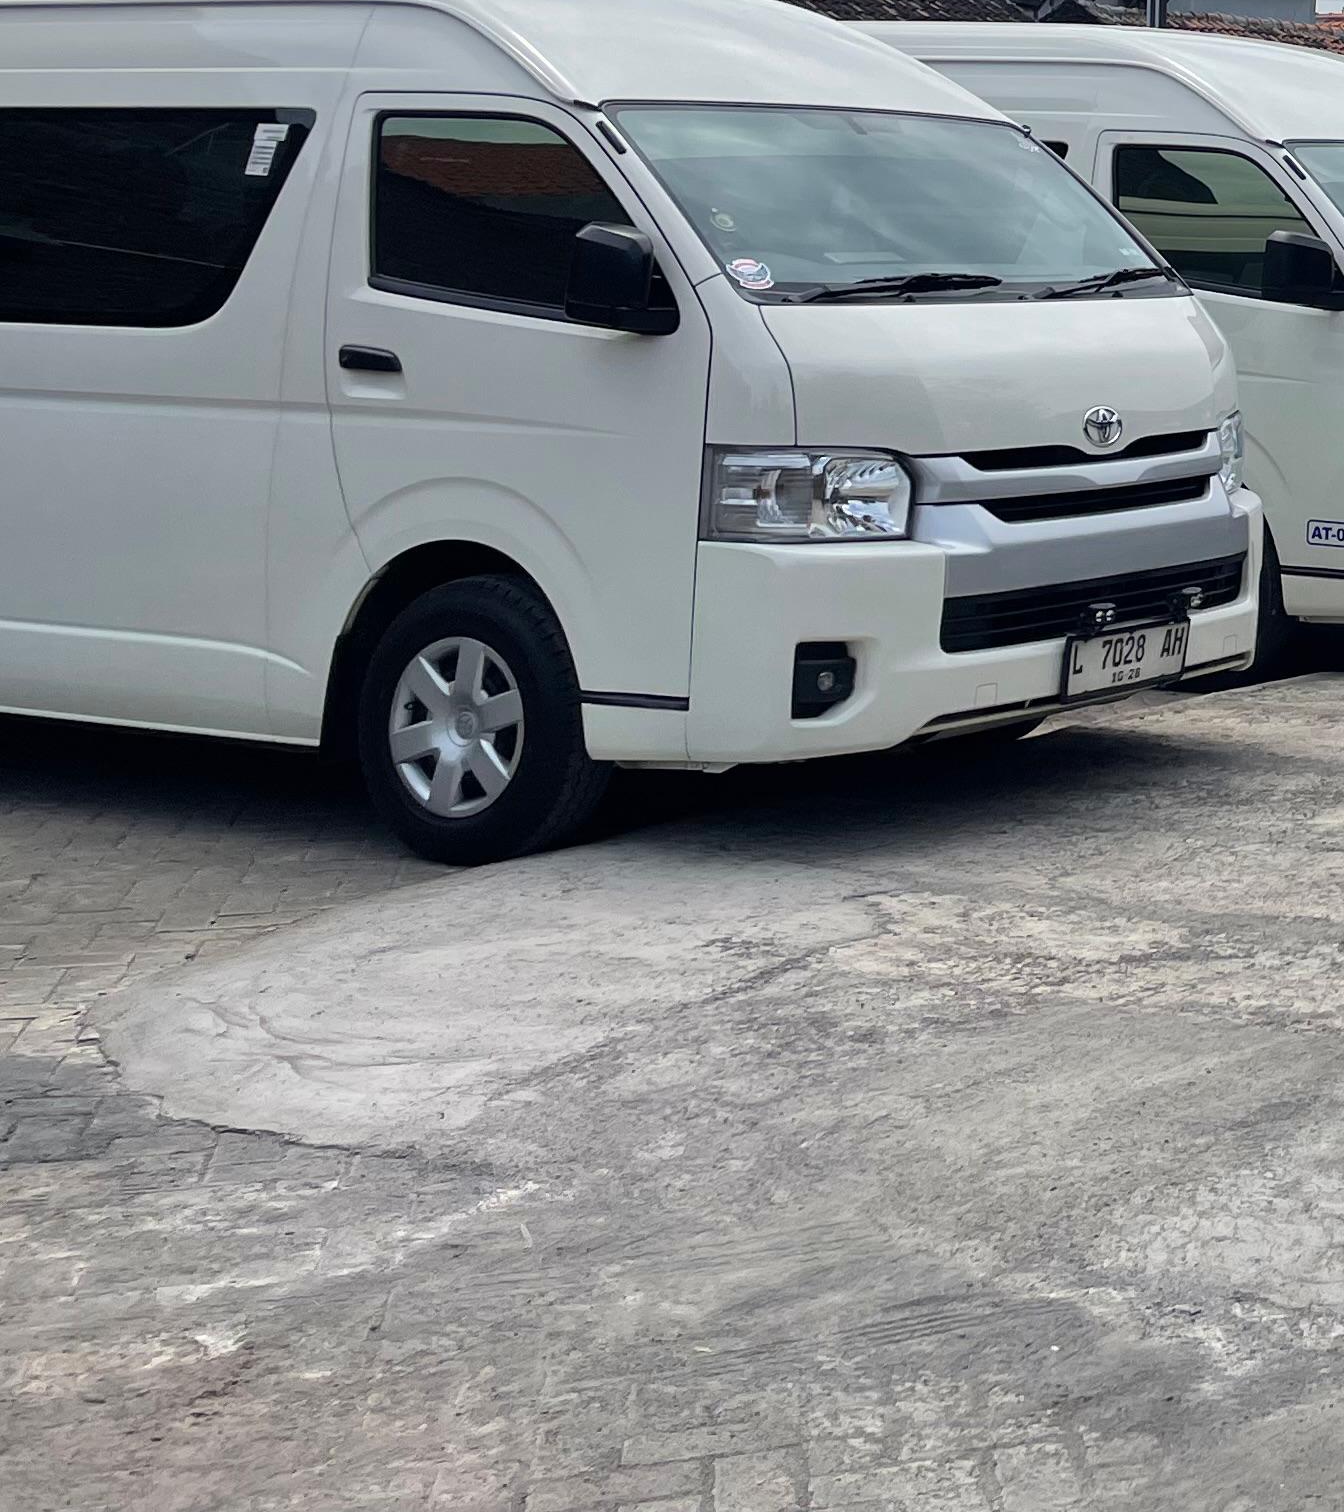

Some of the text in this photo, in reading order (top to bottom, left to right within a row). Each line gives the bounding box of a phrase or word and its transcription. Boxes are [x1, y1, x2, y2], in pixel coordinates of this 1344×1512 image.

[1073, 627, 1185, 675] L 7028 AH
